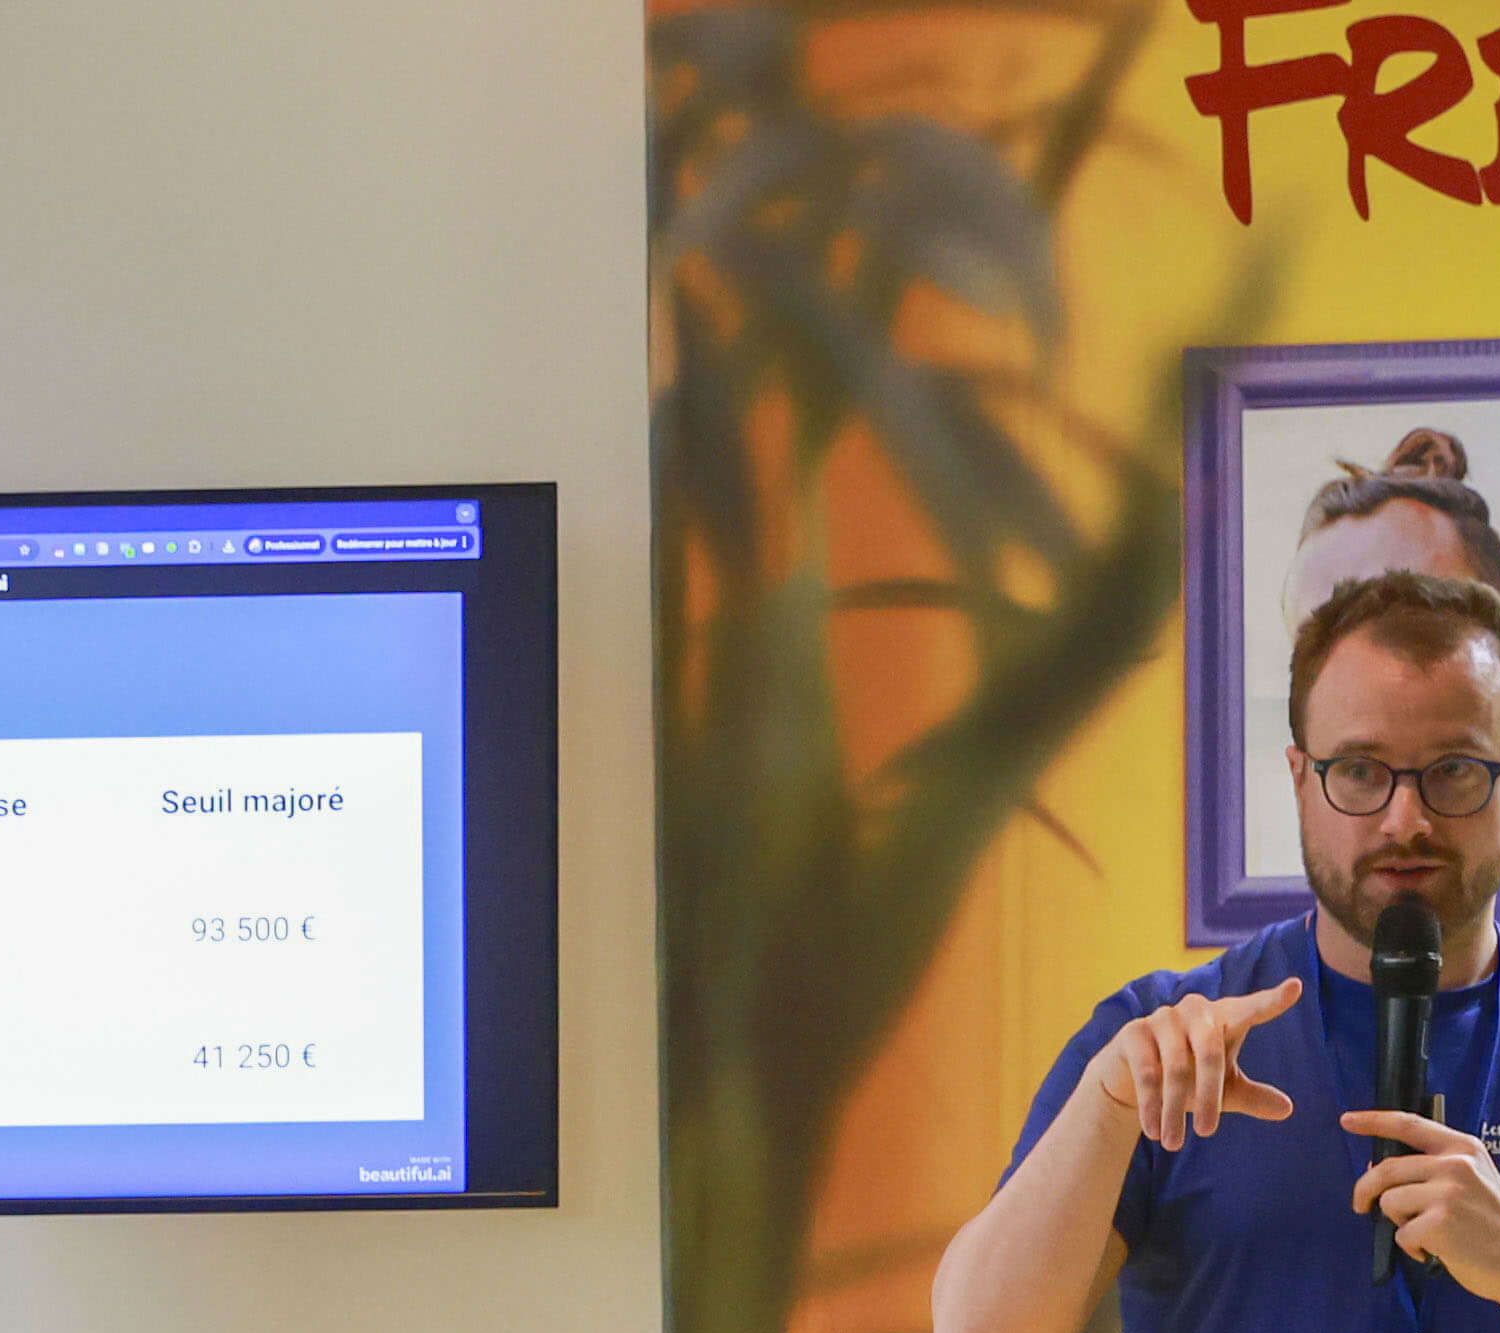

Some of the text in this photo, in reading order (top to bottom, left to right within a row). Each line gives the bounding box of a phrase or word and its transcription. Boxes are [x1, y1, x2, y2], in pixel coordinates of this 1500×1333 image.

[161, 785, 345, 819] Seuil majoré
[190, 915, 316, 943] 93 500 €
[192, 1043, 317, 1070] 41 250 €
[360, 1166, 452, 1182] beautiful.ai
